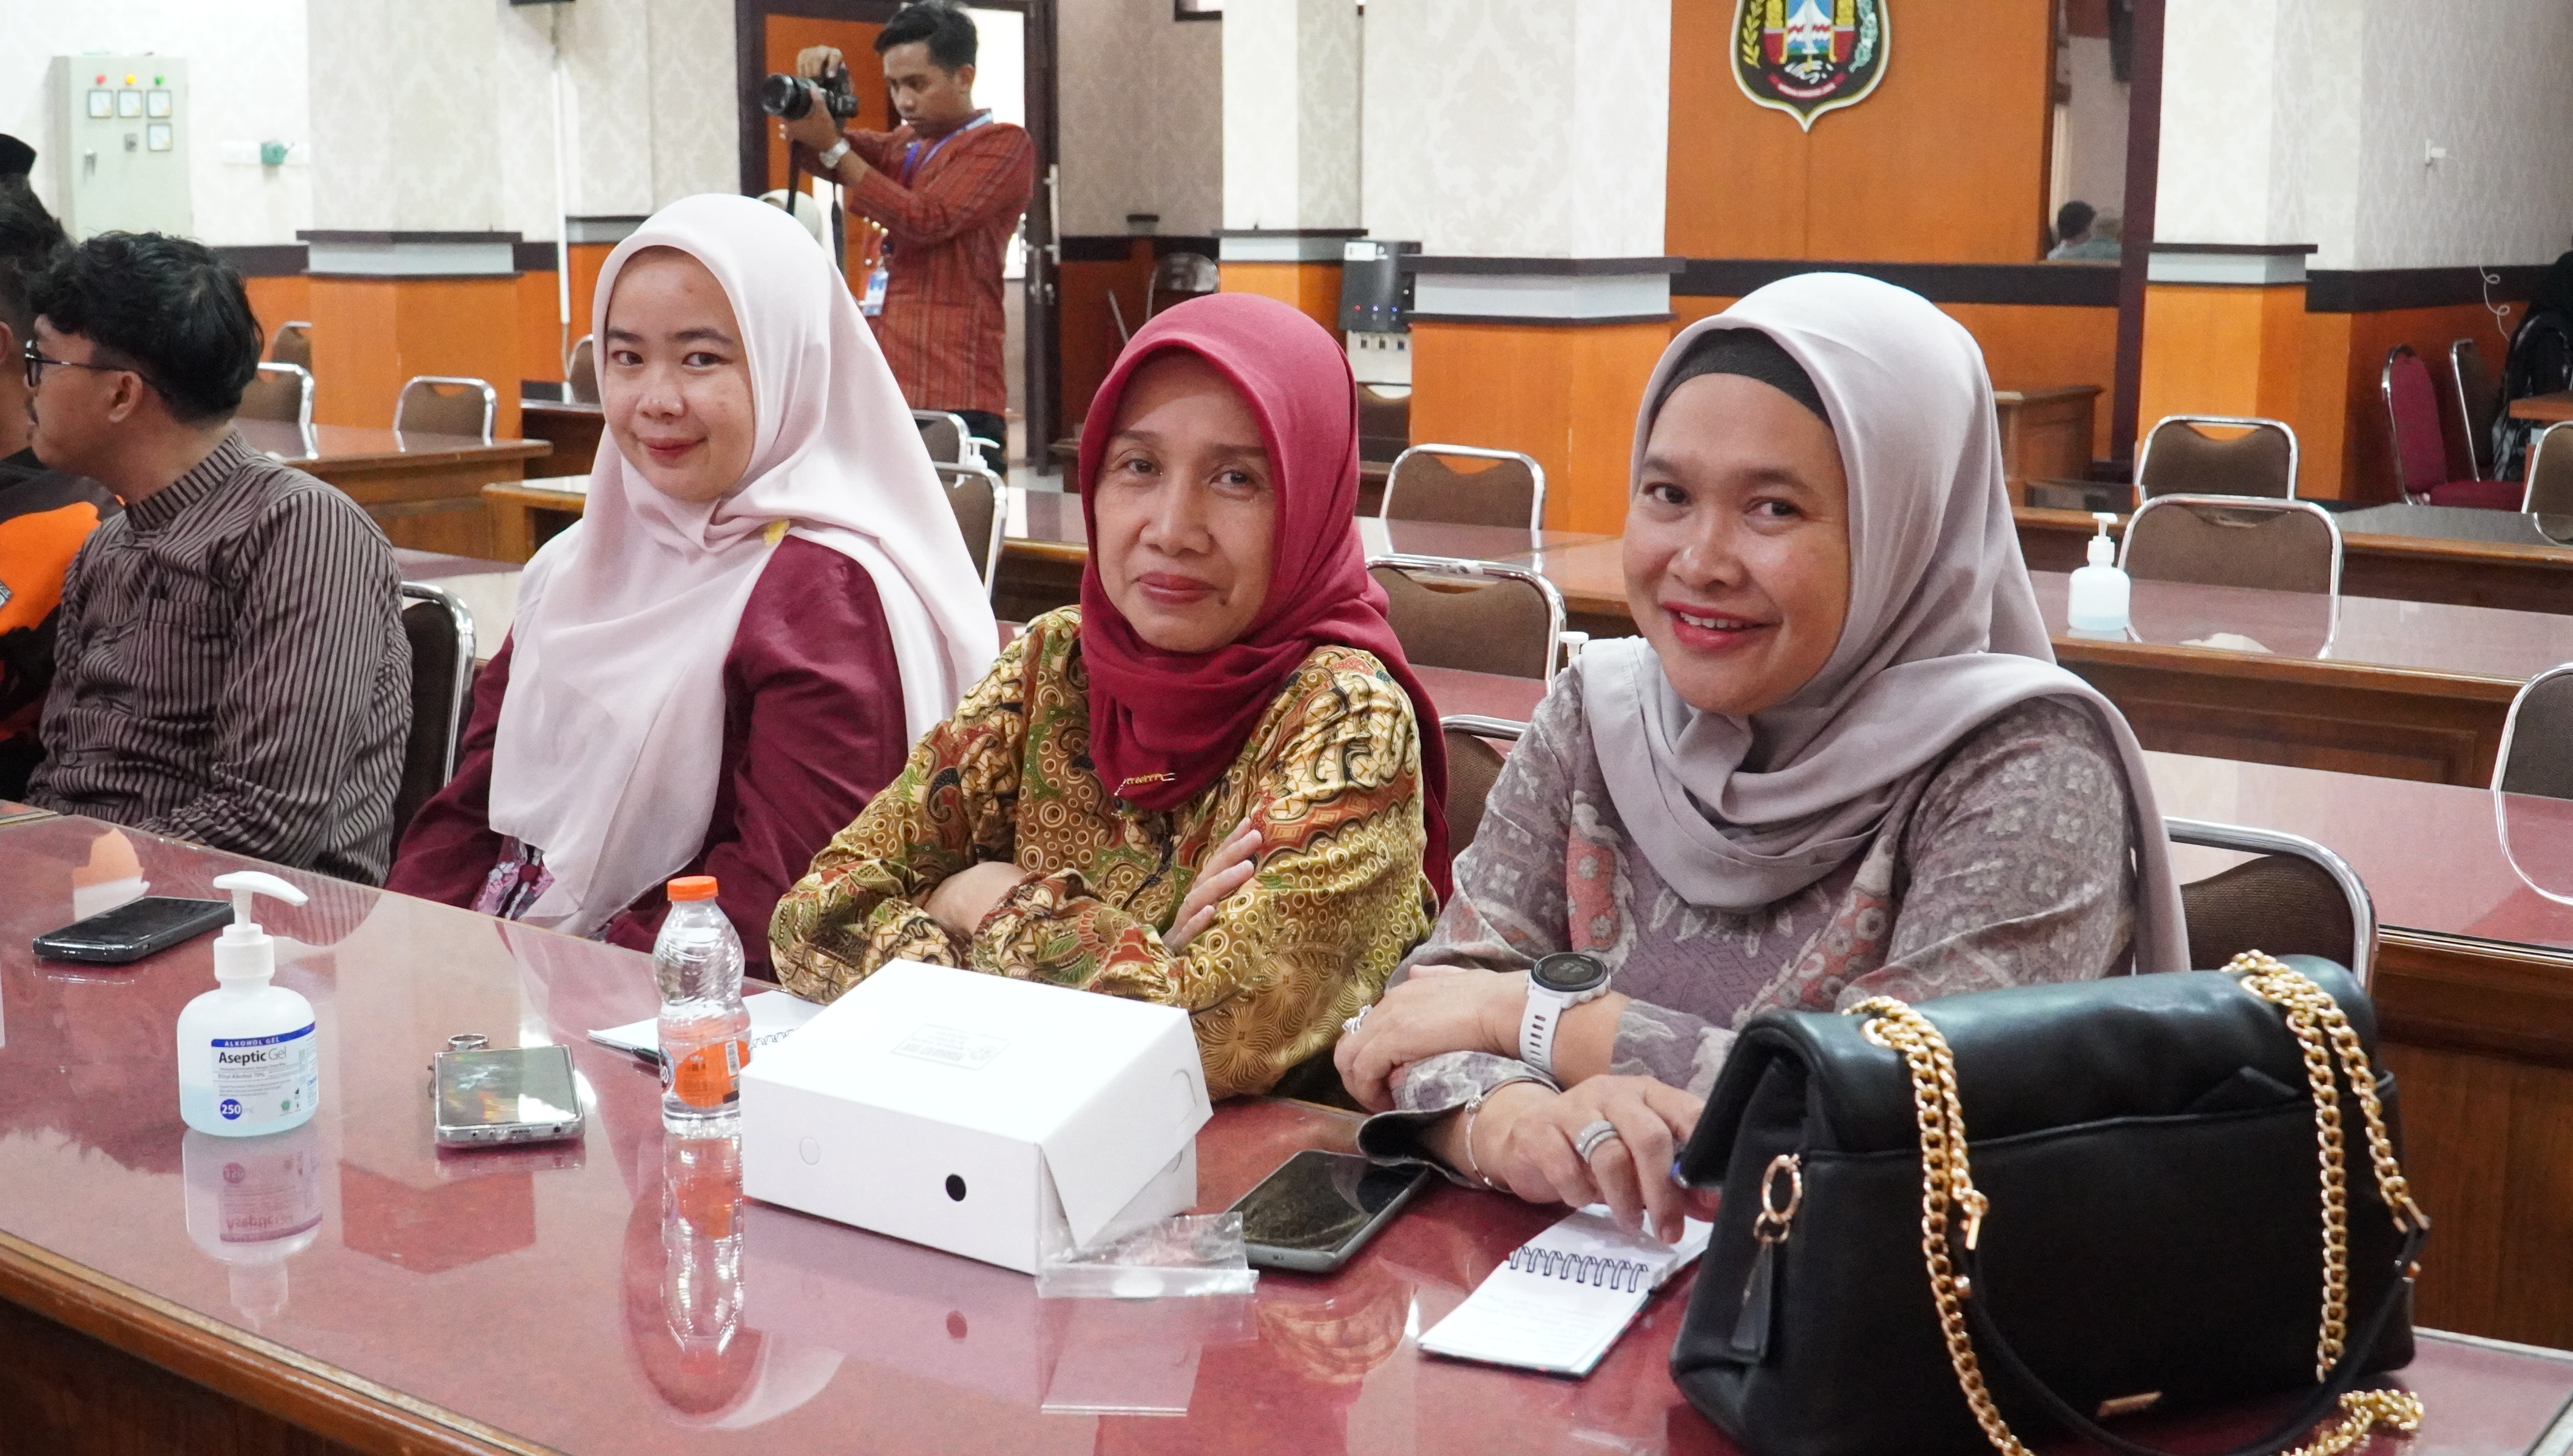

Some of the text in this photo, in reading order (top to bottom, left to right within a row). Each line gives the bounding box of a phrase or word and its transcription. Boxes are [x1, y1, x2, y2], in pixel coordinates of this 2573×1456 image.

[219, 1046, 286, 1066] Aseptic Gel
[221, 1104, 242, 1114] 250
